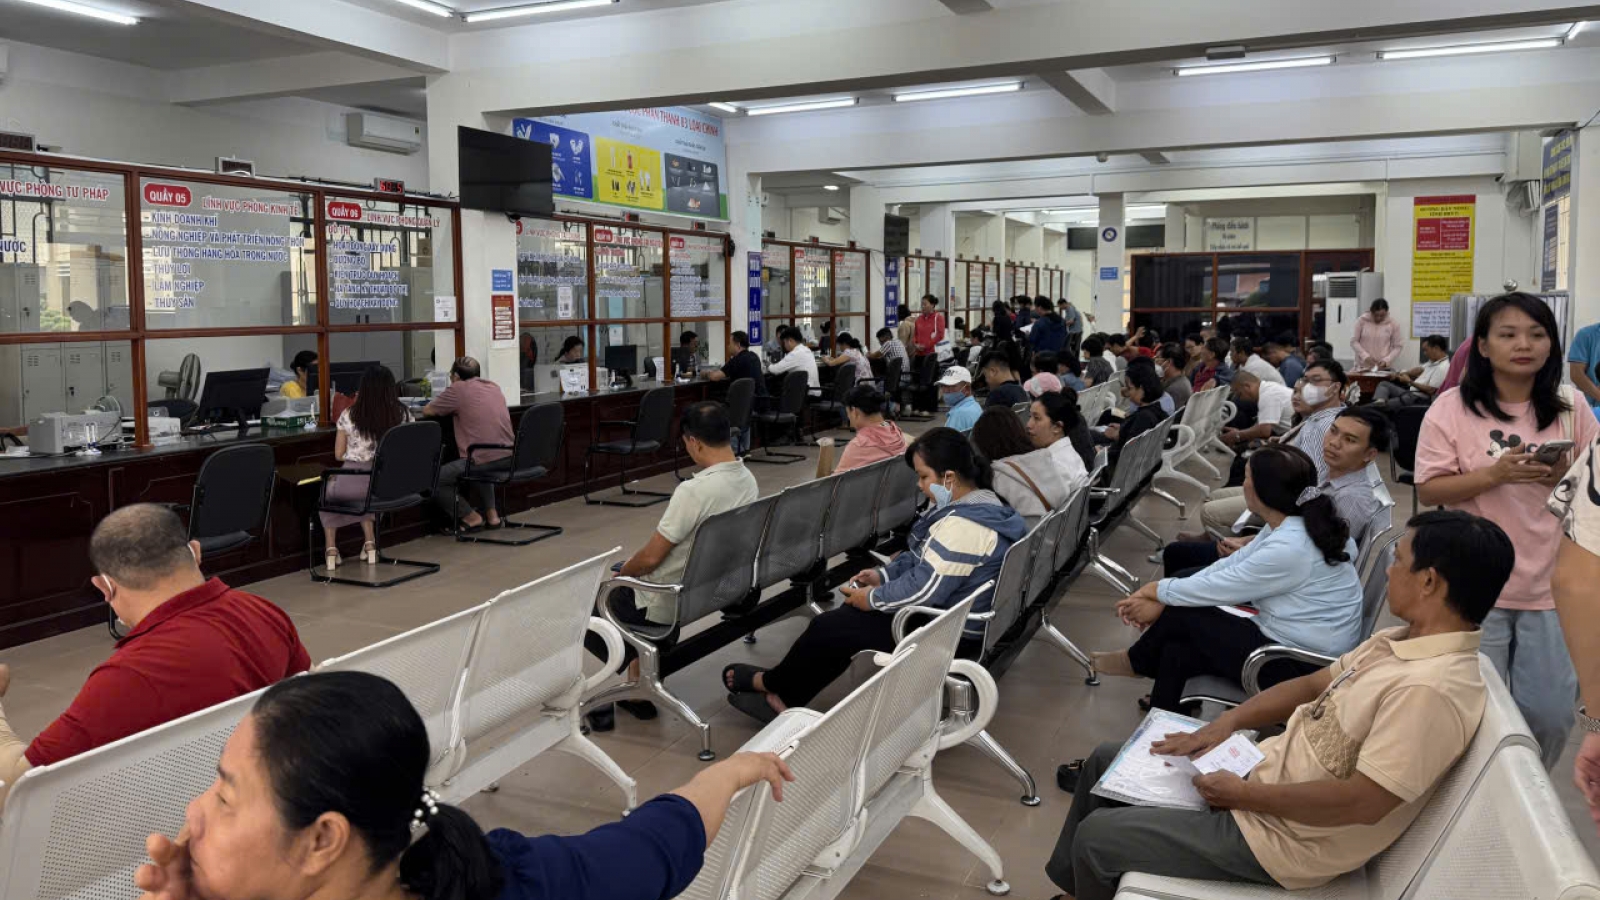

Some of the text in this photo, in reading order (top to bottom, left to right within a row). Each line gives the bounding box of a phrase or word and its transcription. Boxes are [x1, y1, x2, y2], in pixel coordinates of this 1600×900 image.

[25, 178, 62, 197] PHÒNG
[66, 185, 79, 198] TƯ
[82, 184, 109, 200] PHÁP
[150, 187, 187, 203] QUẦY 05
[202, 196, 299, 216] LĨNH VỰC PHÒNG KINH TẾ
[152, 212, 171, 223] KINH
[174, 214, 202, 225] DOANH
[151, 227, 175, 240] NÔNG
[178, 229, 207, 244] NGHIỆP
[209, 230, 220, 243] VÀ
[222, 230, 241, 244] PHÁT
[242, 229, 264, 245] TRIỂN
[265, 232, 286, 246] NÔNG
[153, 246, 171, 258] LƯU
[172, 245, 200, 259] THÔNG
[201, 245, 223, 259] HÀNG
[242, 249, 266, 261] TRONG
[268, 247, 288, 262] NƯỚC
[176, 262, 191, 276] LỢI
[154, 278, 205, 293] LÂM NGHIỆP
[178, 293, 195, 308] SẢN
